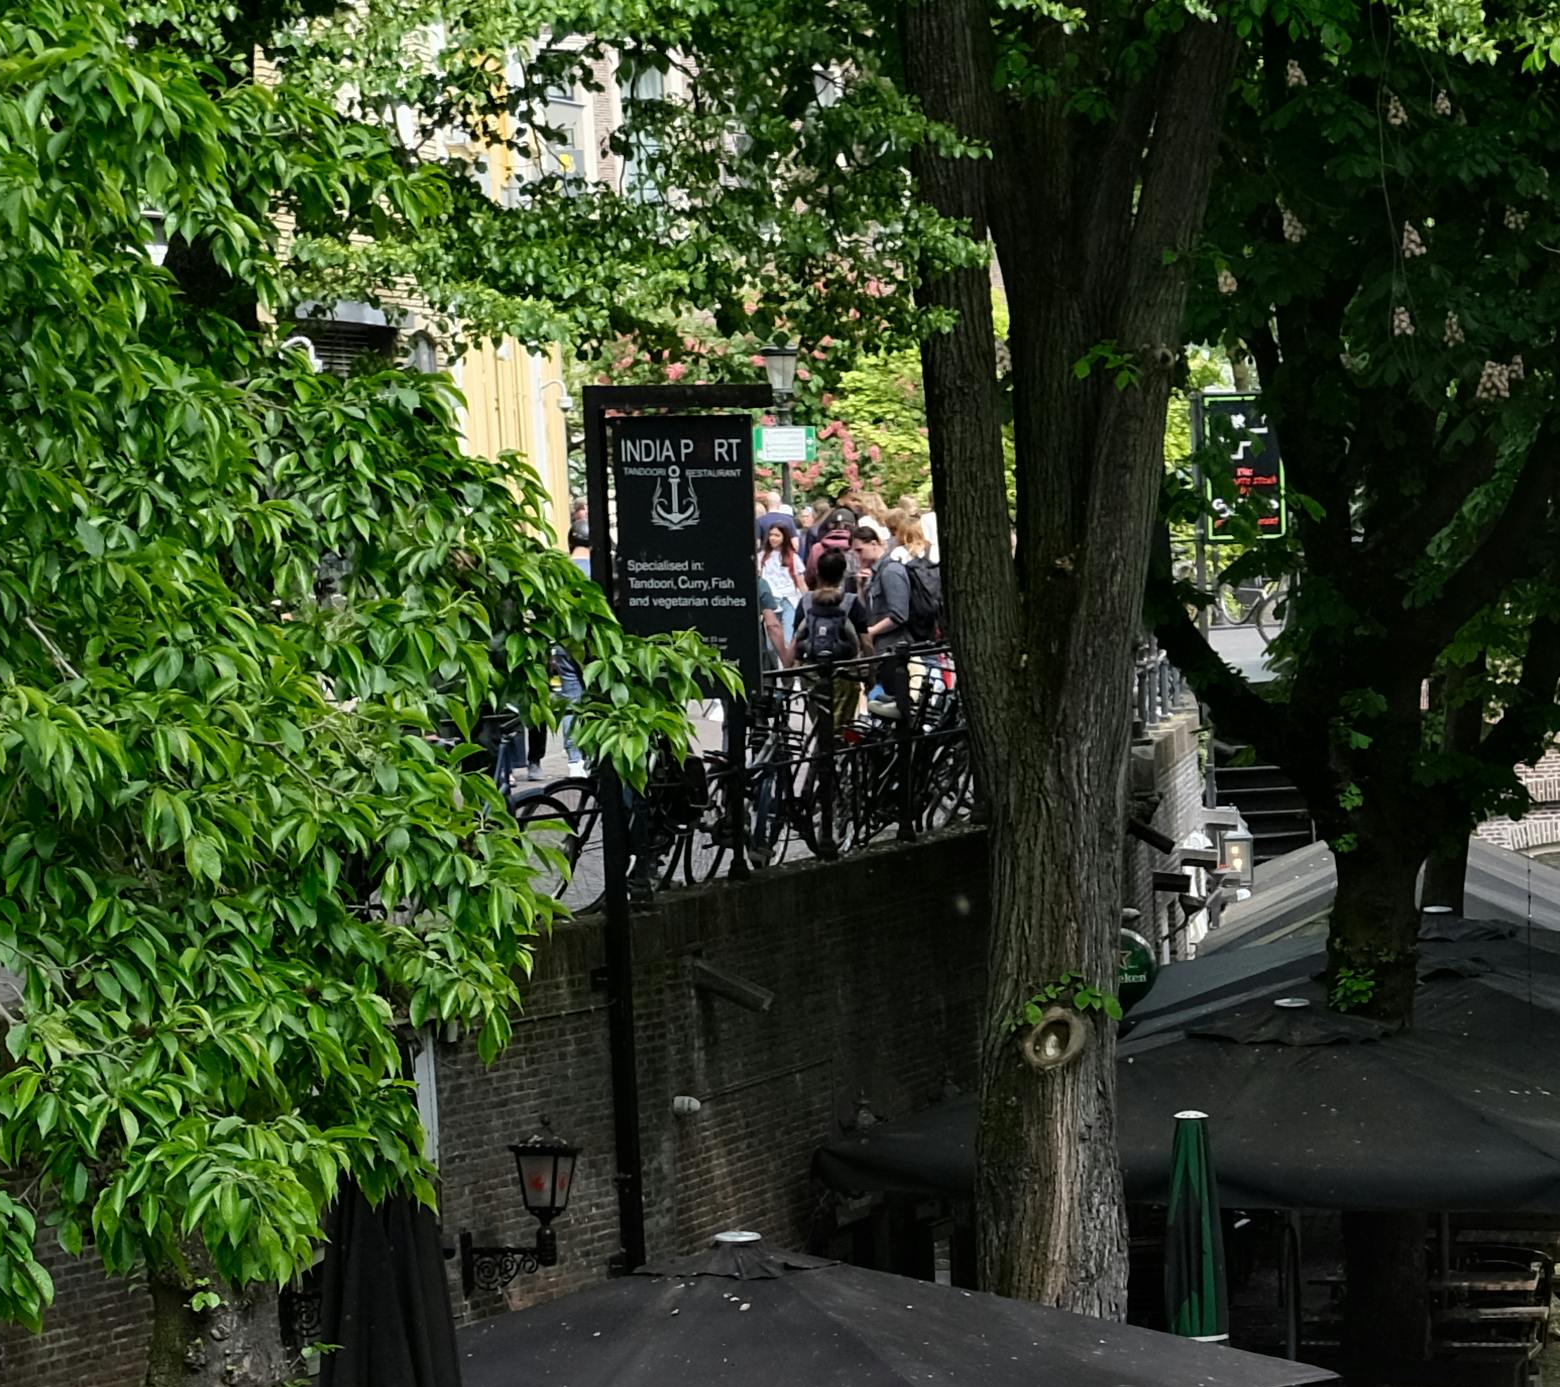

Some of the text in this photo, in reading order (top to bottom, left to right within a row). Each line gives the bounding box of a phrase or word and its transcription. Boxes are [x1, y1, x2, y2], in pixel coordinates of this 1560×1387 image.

[621, 438, 676, 462] INDIA
[680, 439, 741, 462] PRT
[623, 467, 741, 478] TANDOORI RESTAURANT
[627, 560, 704, 573] Specialised in:
[629, 596, 746, 609] and vegetarian dishes
